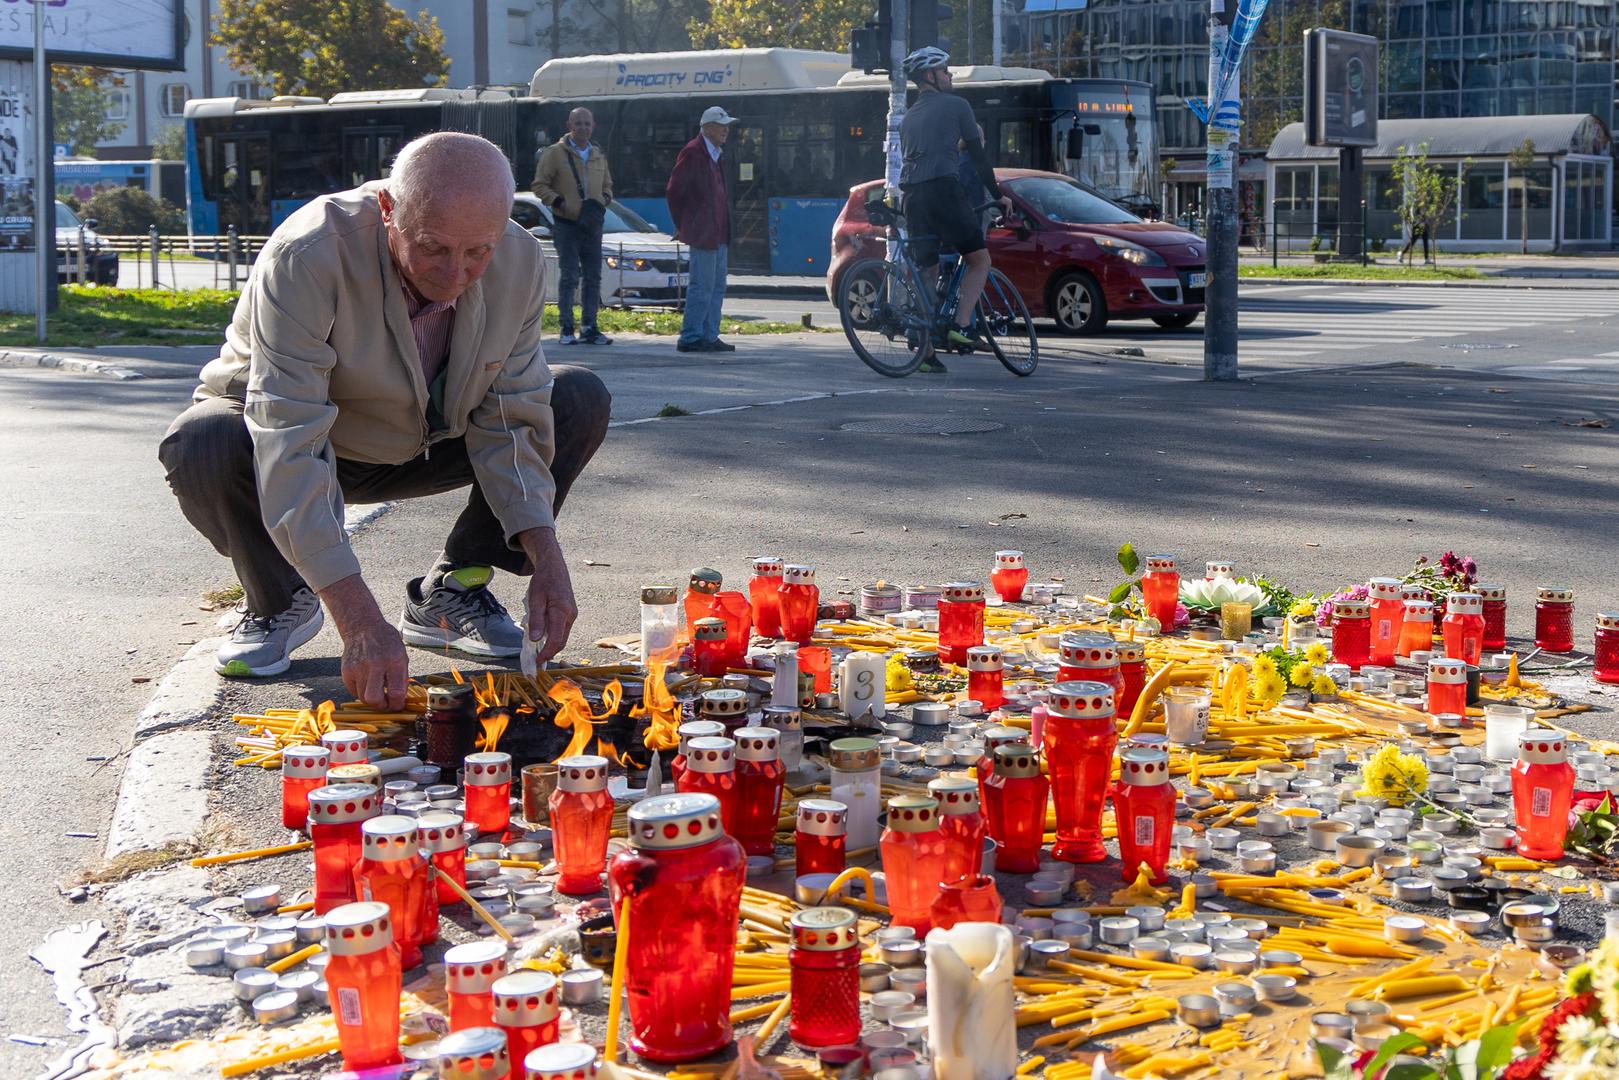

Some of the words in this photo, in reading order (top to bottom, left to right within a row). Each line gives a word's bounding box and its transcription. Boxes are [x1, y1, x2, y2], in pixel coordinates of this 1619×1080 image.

[0, 8, 70, 36] ŠTAJ
[694, 71, 725, 85] CNG
[5, 215, 34, 224] GRUPA
[854, 670, 875, 701] 3
